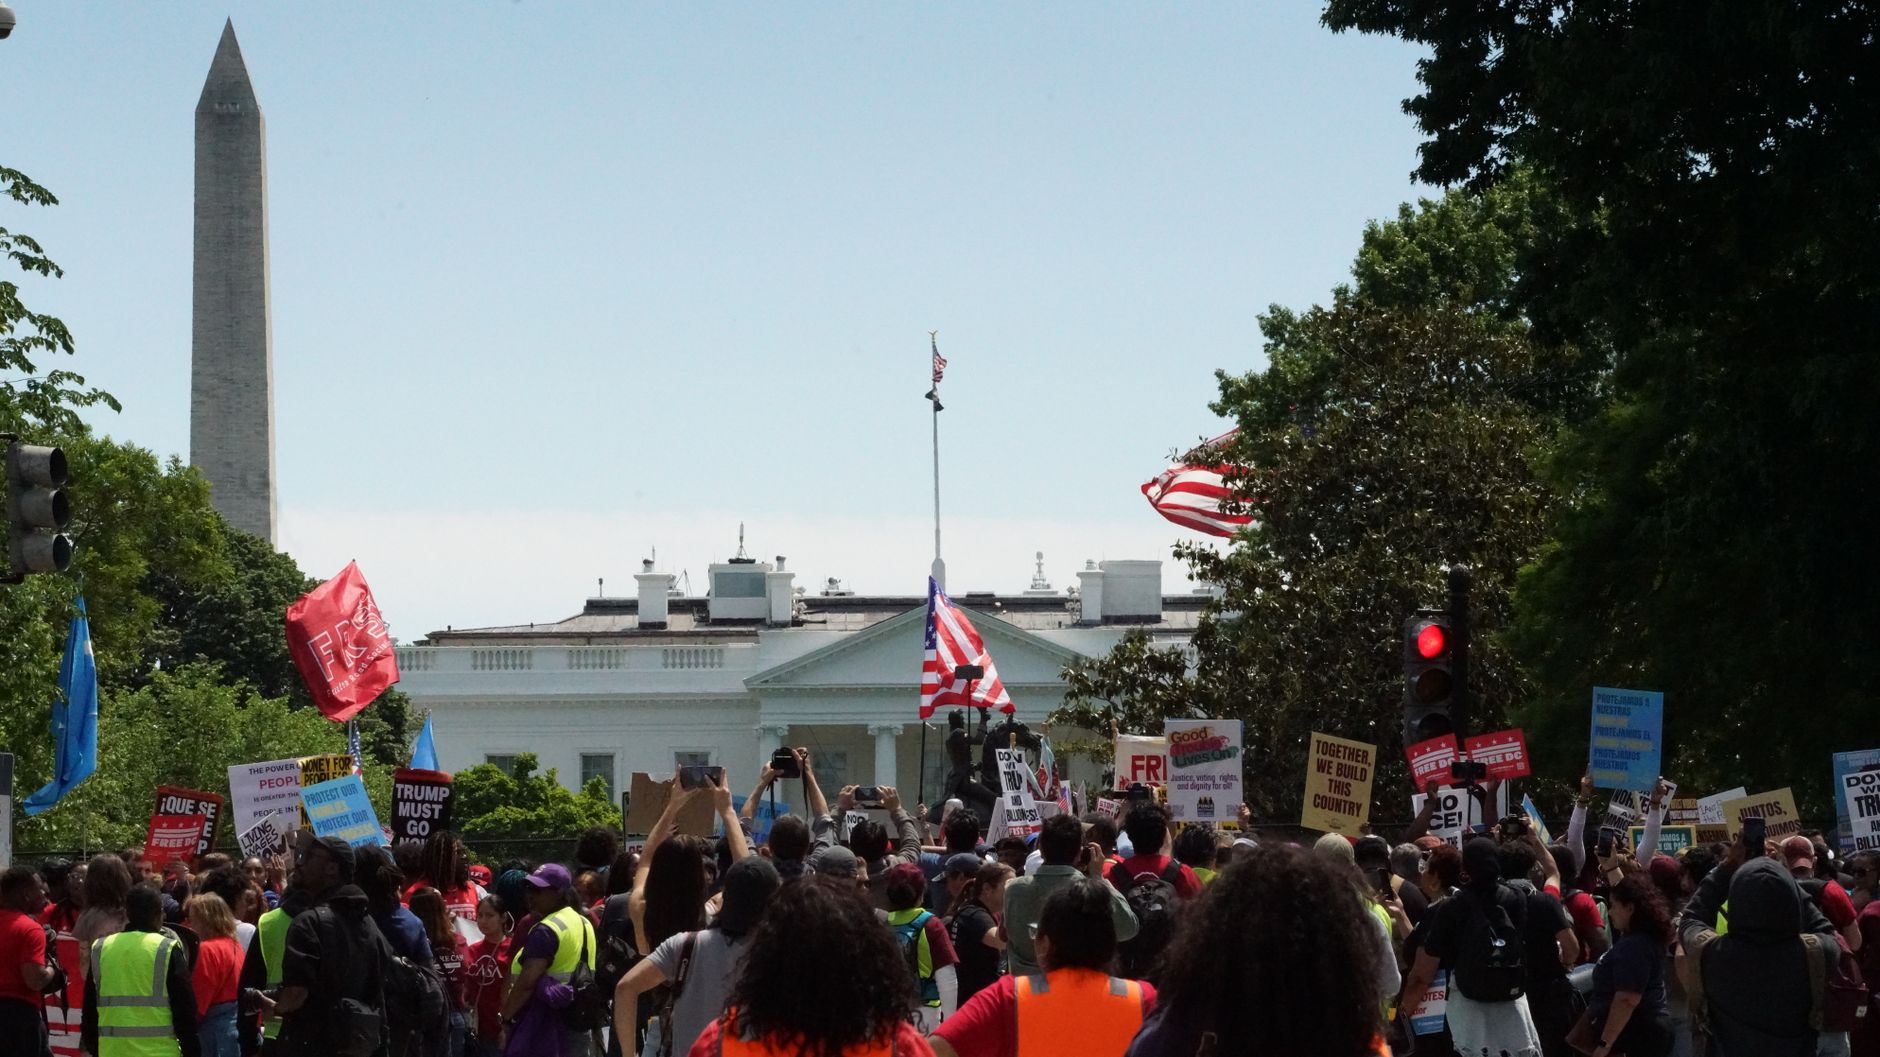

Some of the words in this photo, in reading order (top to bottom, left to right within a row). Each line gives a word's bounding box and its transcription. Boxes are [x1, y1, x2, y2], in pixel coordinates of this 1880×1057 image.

[1171, 727, 1208, 744] Good
[1174, 752, 1210, 768] Lives
[1315, 740, 1372, 767] TOGETHER,
[1505, 751, 1523, 762] DC
[265, 763, 295, 773] POWER
[301, 759, 331, 773] MONEY
[333, 757, 351, 771] FOR
[1316, 758, 1334, 776] WE
[1334, 763, 1368, 782] BUILD
[1413, 761, 1438, 777] FREE
[259, 776, 300, 789] PEOPL
[1170, 774, 1194, 783] Justice,
[1195, 775, 1216, 784] voting
[1190, 783, 1212, 791] dignity
[1327, 778, 1352, 797] THIS
[261, 794, 285, 802] GREATER
[305, 787, 341, 806] PROTECT
[340, 783, 359, 797] OUR
[395, 783, 450, 802] TRUMP
[197, 801, 217, 819] SE
[398, 801, 443, 819] MUST
[1313, 793, 1363, 818] COUNTRY
[1738, 801, 1788, 823] JUNTOS,
[316, 814, 351, 833] PROTECT
[351, 809, 369, 823] OUR
[406, 819, 430, 837] GO
[151, 838, 184, 848] FREE
[184, 837, 197, 847] DC
[241, 820, 273, 849] LIVING
[1422, 991, 1445, 1002] OTES
